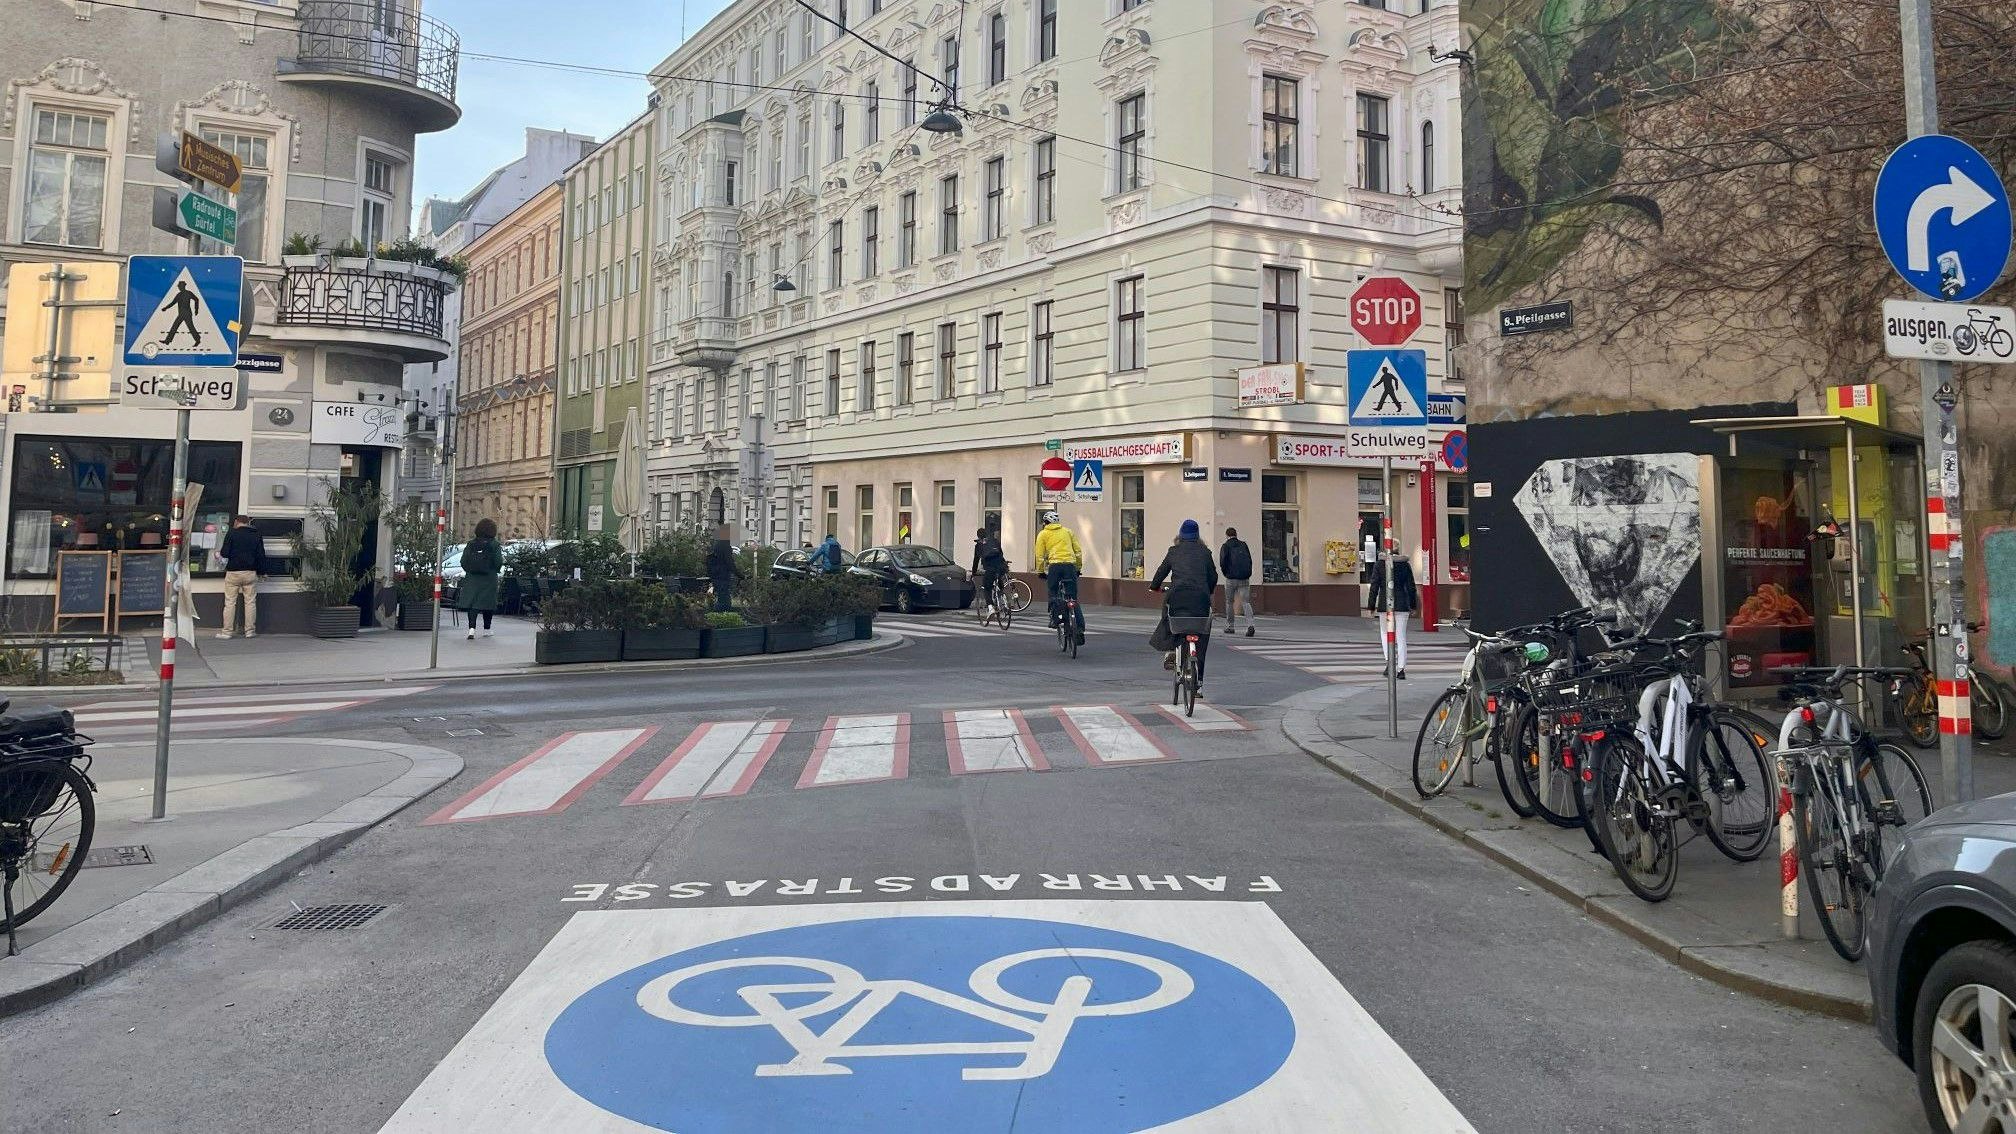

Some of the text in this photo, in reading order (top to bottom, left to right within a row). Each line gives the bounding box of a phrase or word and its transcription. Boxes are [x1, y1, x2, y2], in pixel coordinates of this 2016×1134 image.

[197, 159, 225, 182] Zentrum
[192, 196, 221, 220] Radroute
[1356, 297, 1416, 326] STOP
[1515, 311, 1566, 325] Pfeilgasse
[1887, 317, 1952, 345] ausgen.
[126, 375, 233, 401] Schlweg
[1255, 386, 1280, 395] STROBL
[275, 410, 289, 419] 24
[326, 405, 355, 417] CAFE
[1351, 433, 1425, 449] Schulweg
[1727, 547, 1757, 559] PERFEKTE
[560, 874, 1284, 902] FAHRRADSTRASSE
